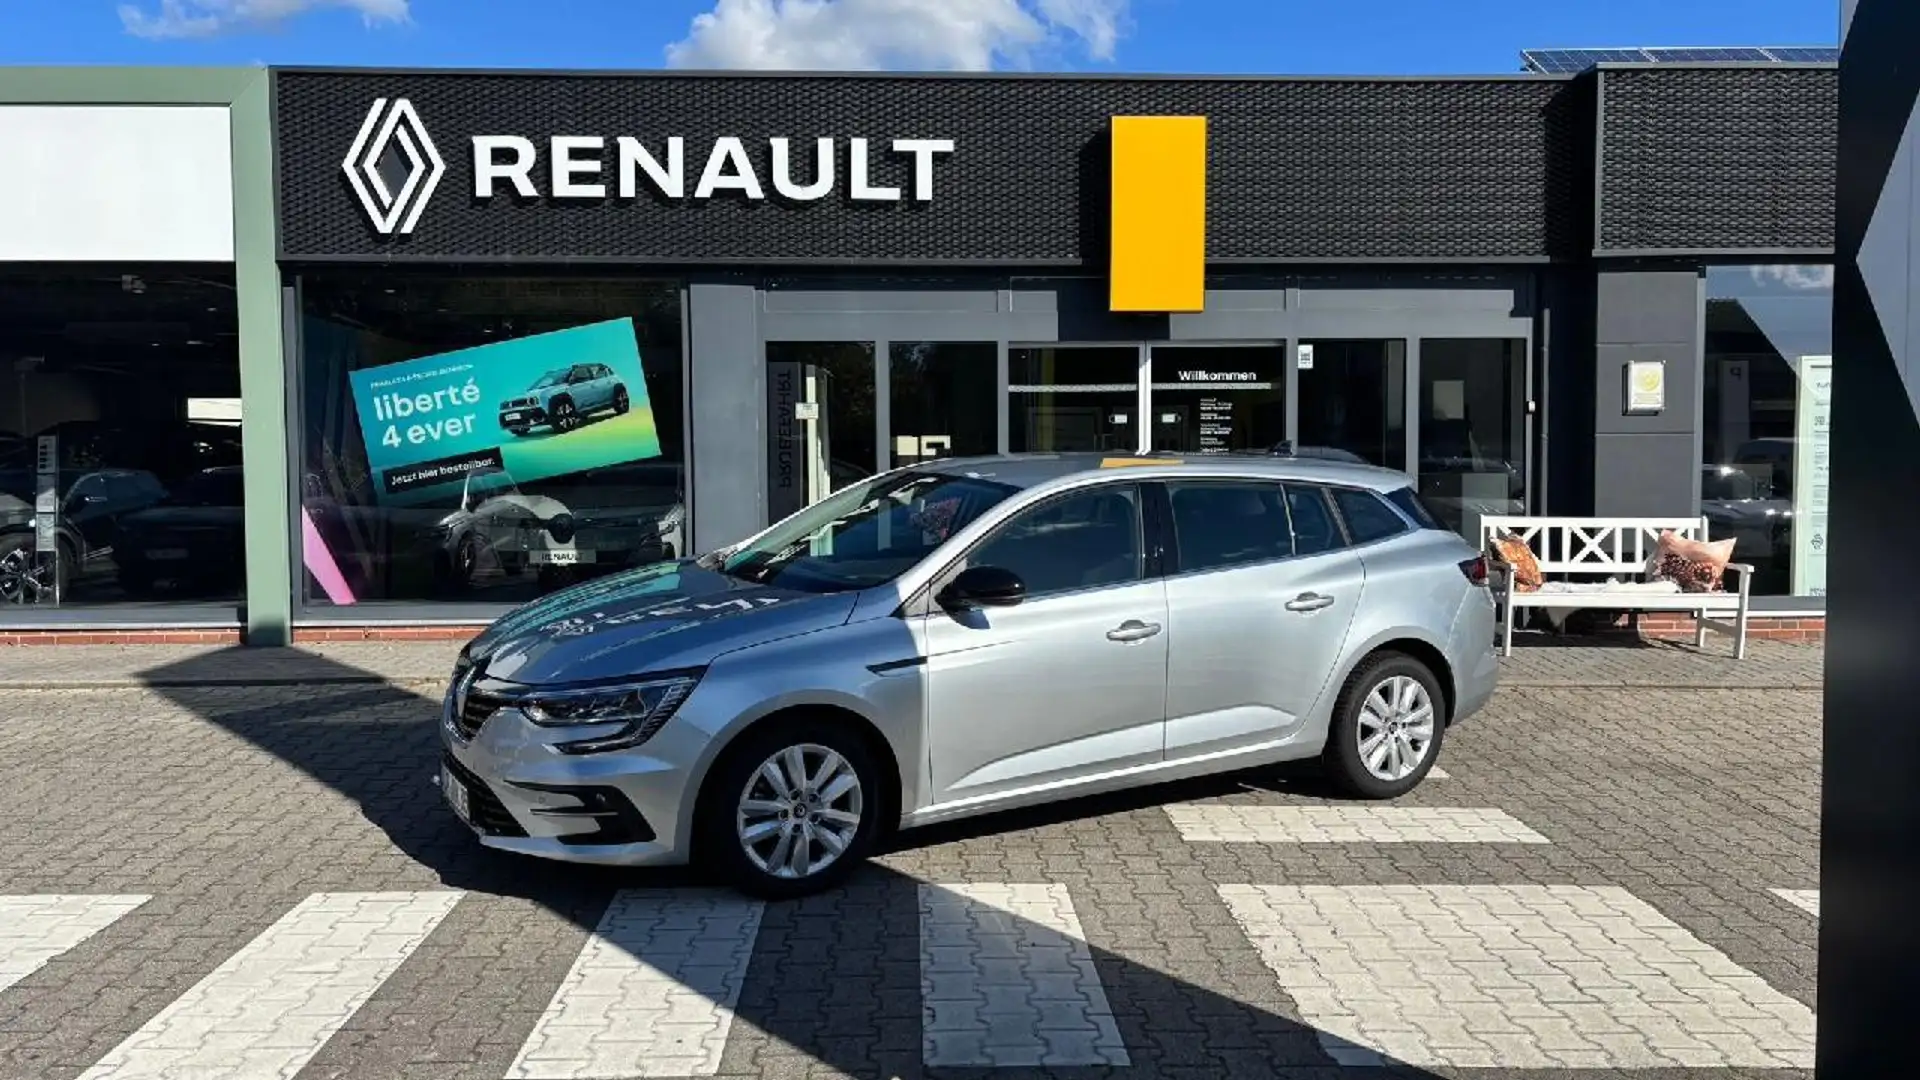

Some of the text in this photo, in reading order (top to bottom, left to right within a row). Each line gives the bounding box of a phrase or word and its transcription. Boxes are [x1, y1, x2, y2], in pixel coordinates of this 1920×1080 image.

[472, 134, 955, 201] RENAULT
[1178, 370, 1257, 381] Willkommen
[373, 376, 480, 421] liberté
[382, 413, 476, 448] 4 ever
[391, 472, 417, 486] Jetzt
[418, 469, 438, 480] hier
